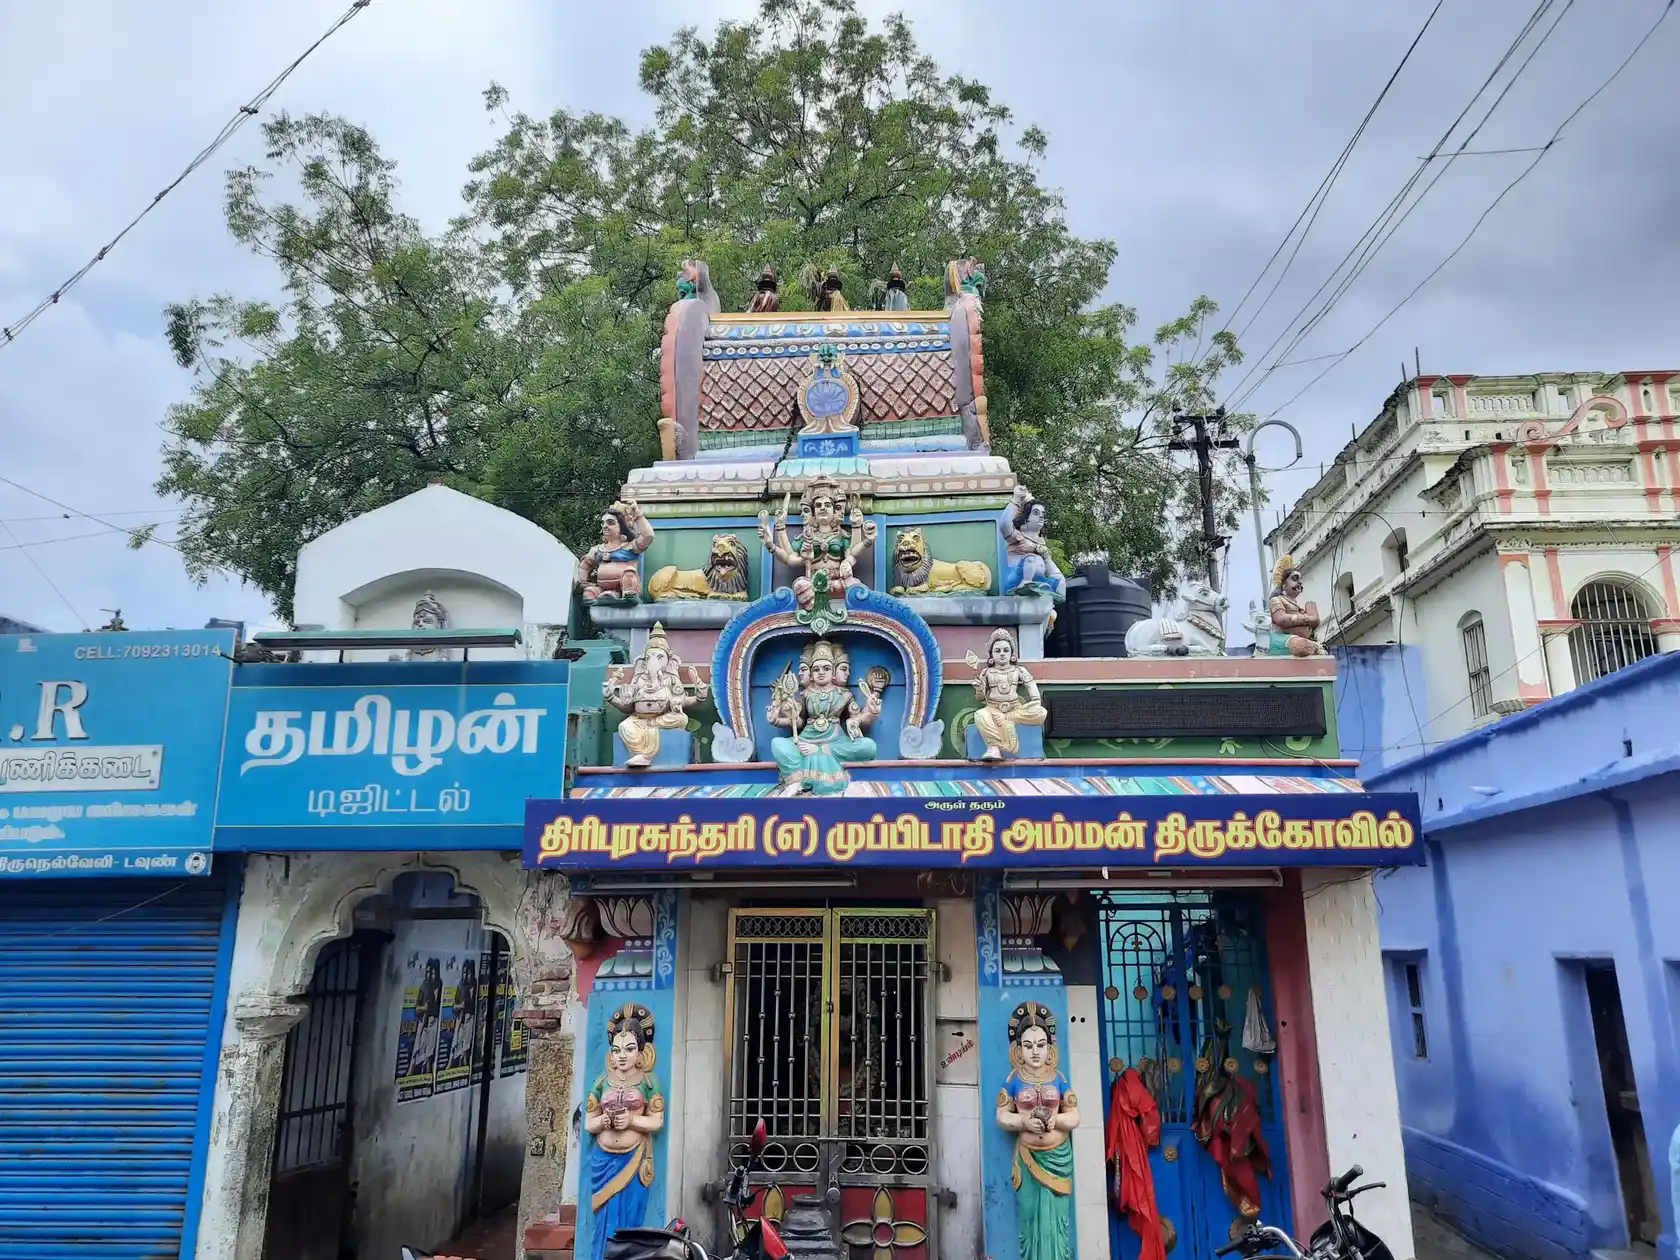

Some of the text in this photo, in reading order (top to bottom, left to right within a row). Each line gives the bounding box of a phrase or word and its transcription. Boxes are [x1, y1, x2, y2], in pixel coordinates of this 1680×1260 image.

[74, 643, 222, 660] CELL:7092313014
[240, 692, 548, 777] தமிழன்
[0, 751, 151, 785] ணிக்கடை
[307, 782, 471, 817] டிஜிட்டல்
[924, 799, 1006, 812] அருள் தரும்
[537, 810, 1415, 864] திரிபுரசுந்தரி (எ) முப்பிடாதி அம்மன் திருக்கோவில்
